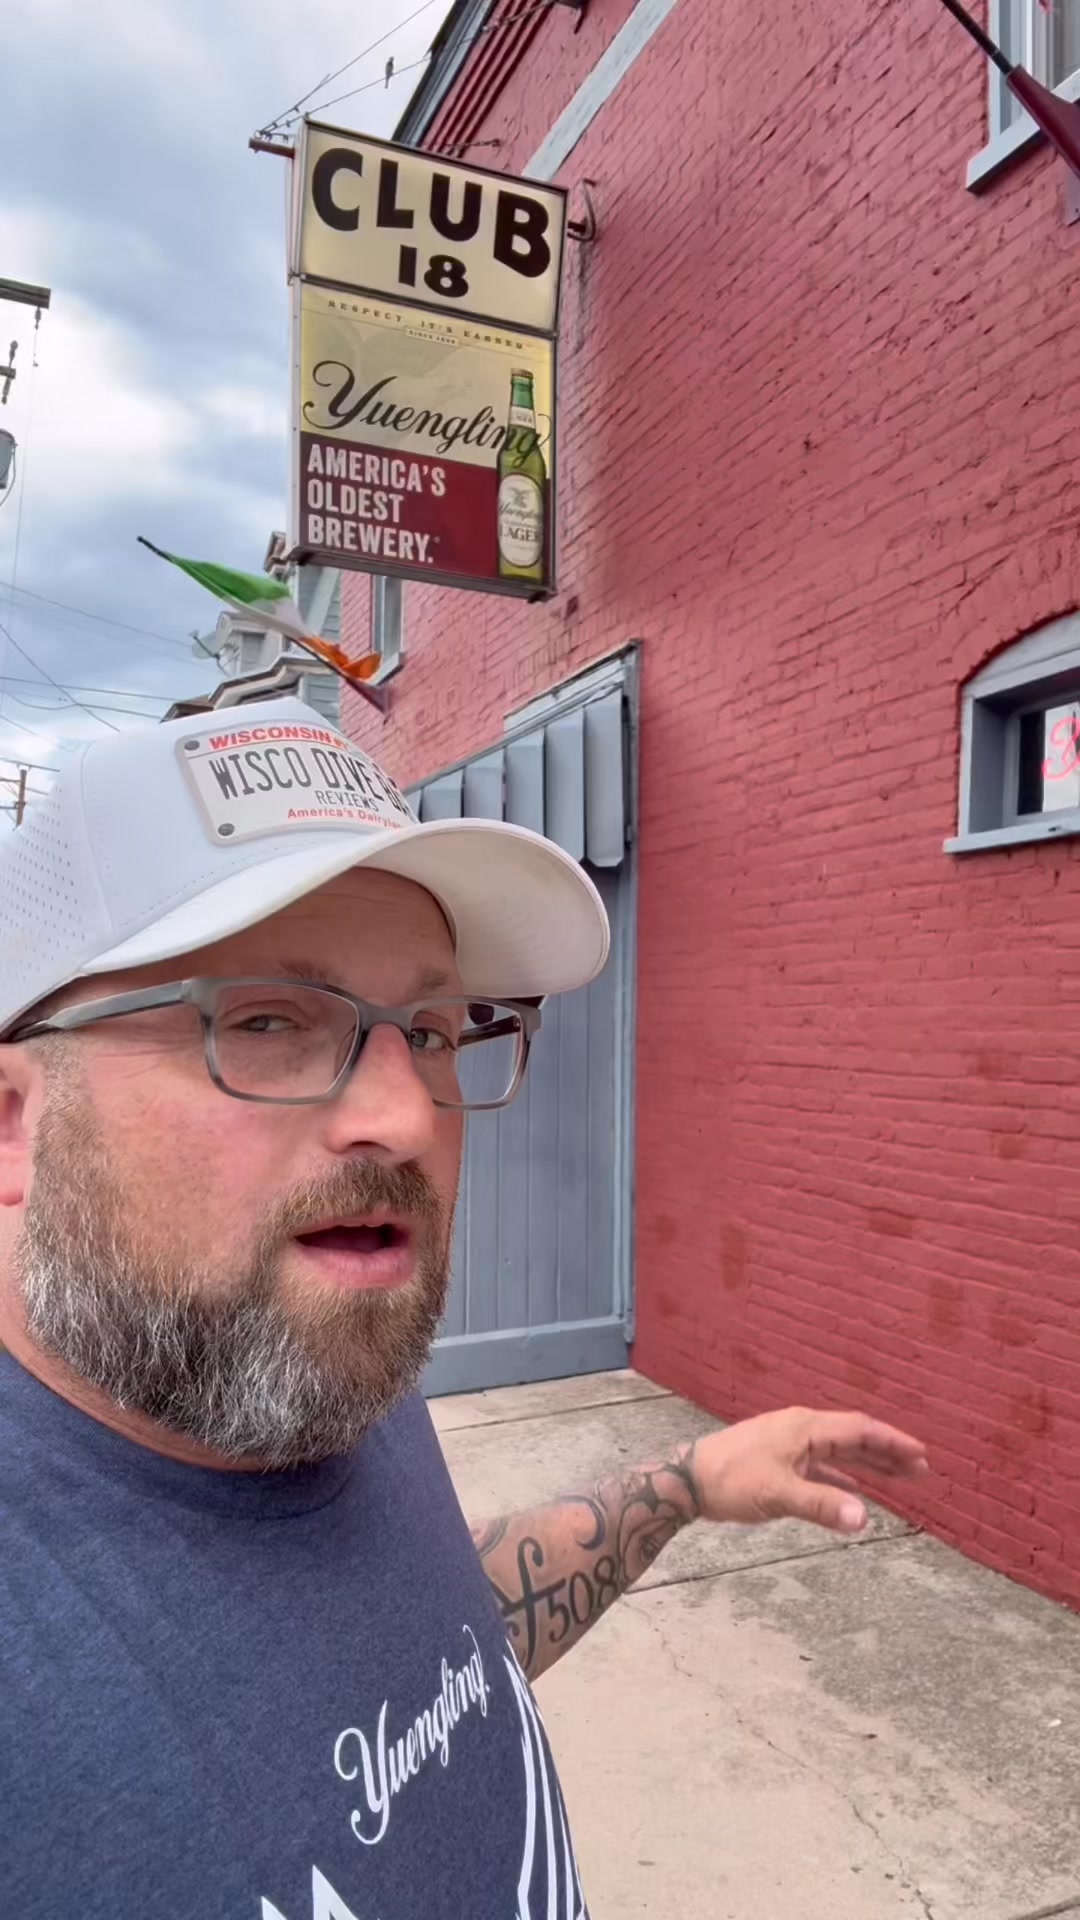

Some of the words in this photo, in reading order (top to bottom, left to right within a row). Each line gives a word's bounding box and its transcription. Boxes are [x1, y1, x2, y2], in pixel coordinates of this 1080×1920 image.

[311, 147, 551, 278] CLUB
[398, 244, 469, 298] 18
[328, 300, 402, 322] RESPECT
[303, 360, 552, 469] Yuengling
[307, 443, 446, 497] AMERICA'S
[307, 478, 404, 523] OLDEST
[307, 514, 434, 563] BREWERY.
[209, 727, 331, 750] WISCONSIN
[208, 747, 312, 800] WISCO
[310, 747, 385, 802] DIVE
[287, 807, 354, 820] America's
[357, 809, 402, 829] Dairyla
[315, 790, 379, 812] REVIEWS
